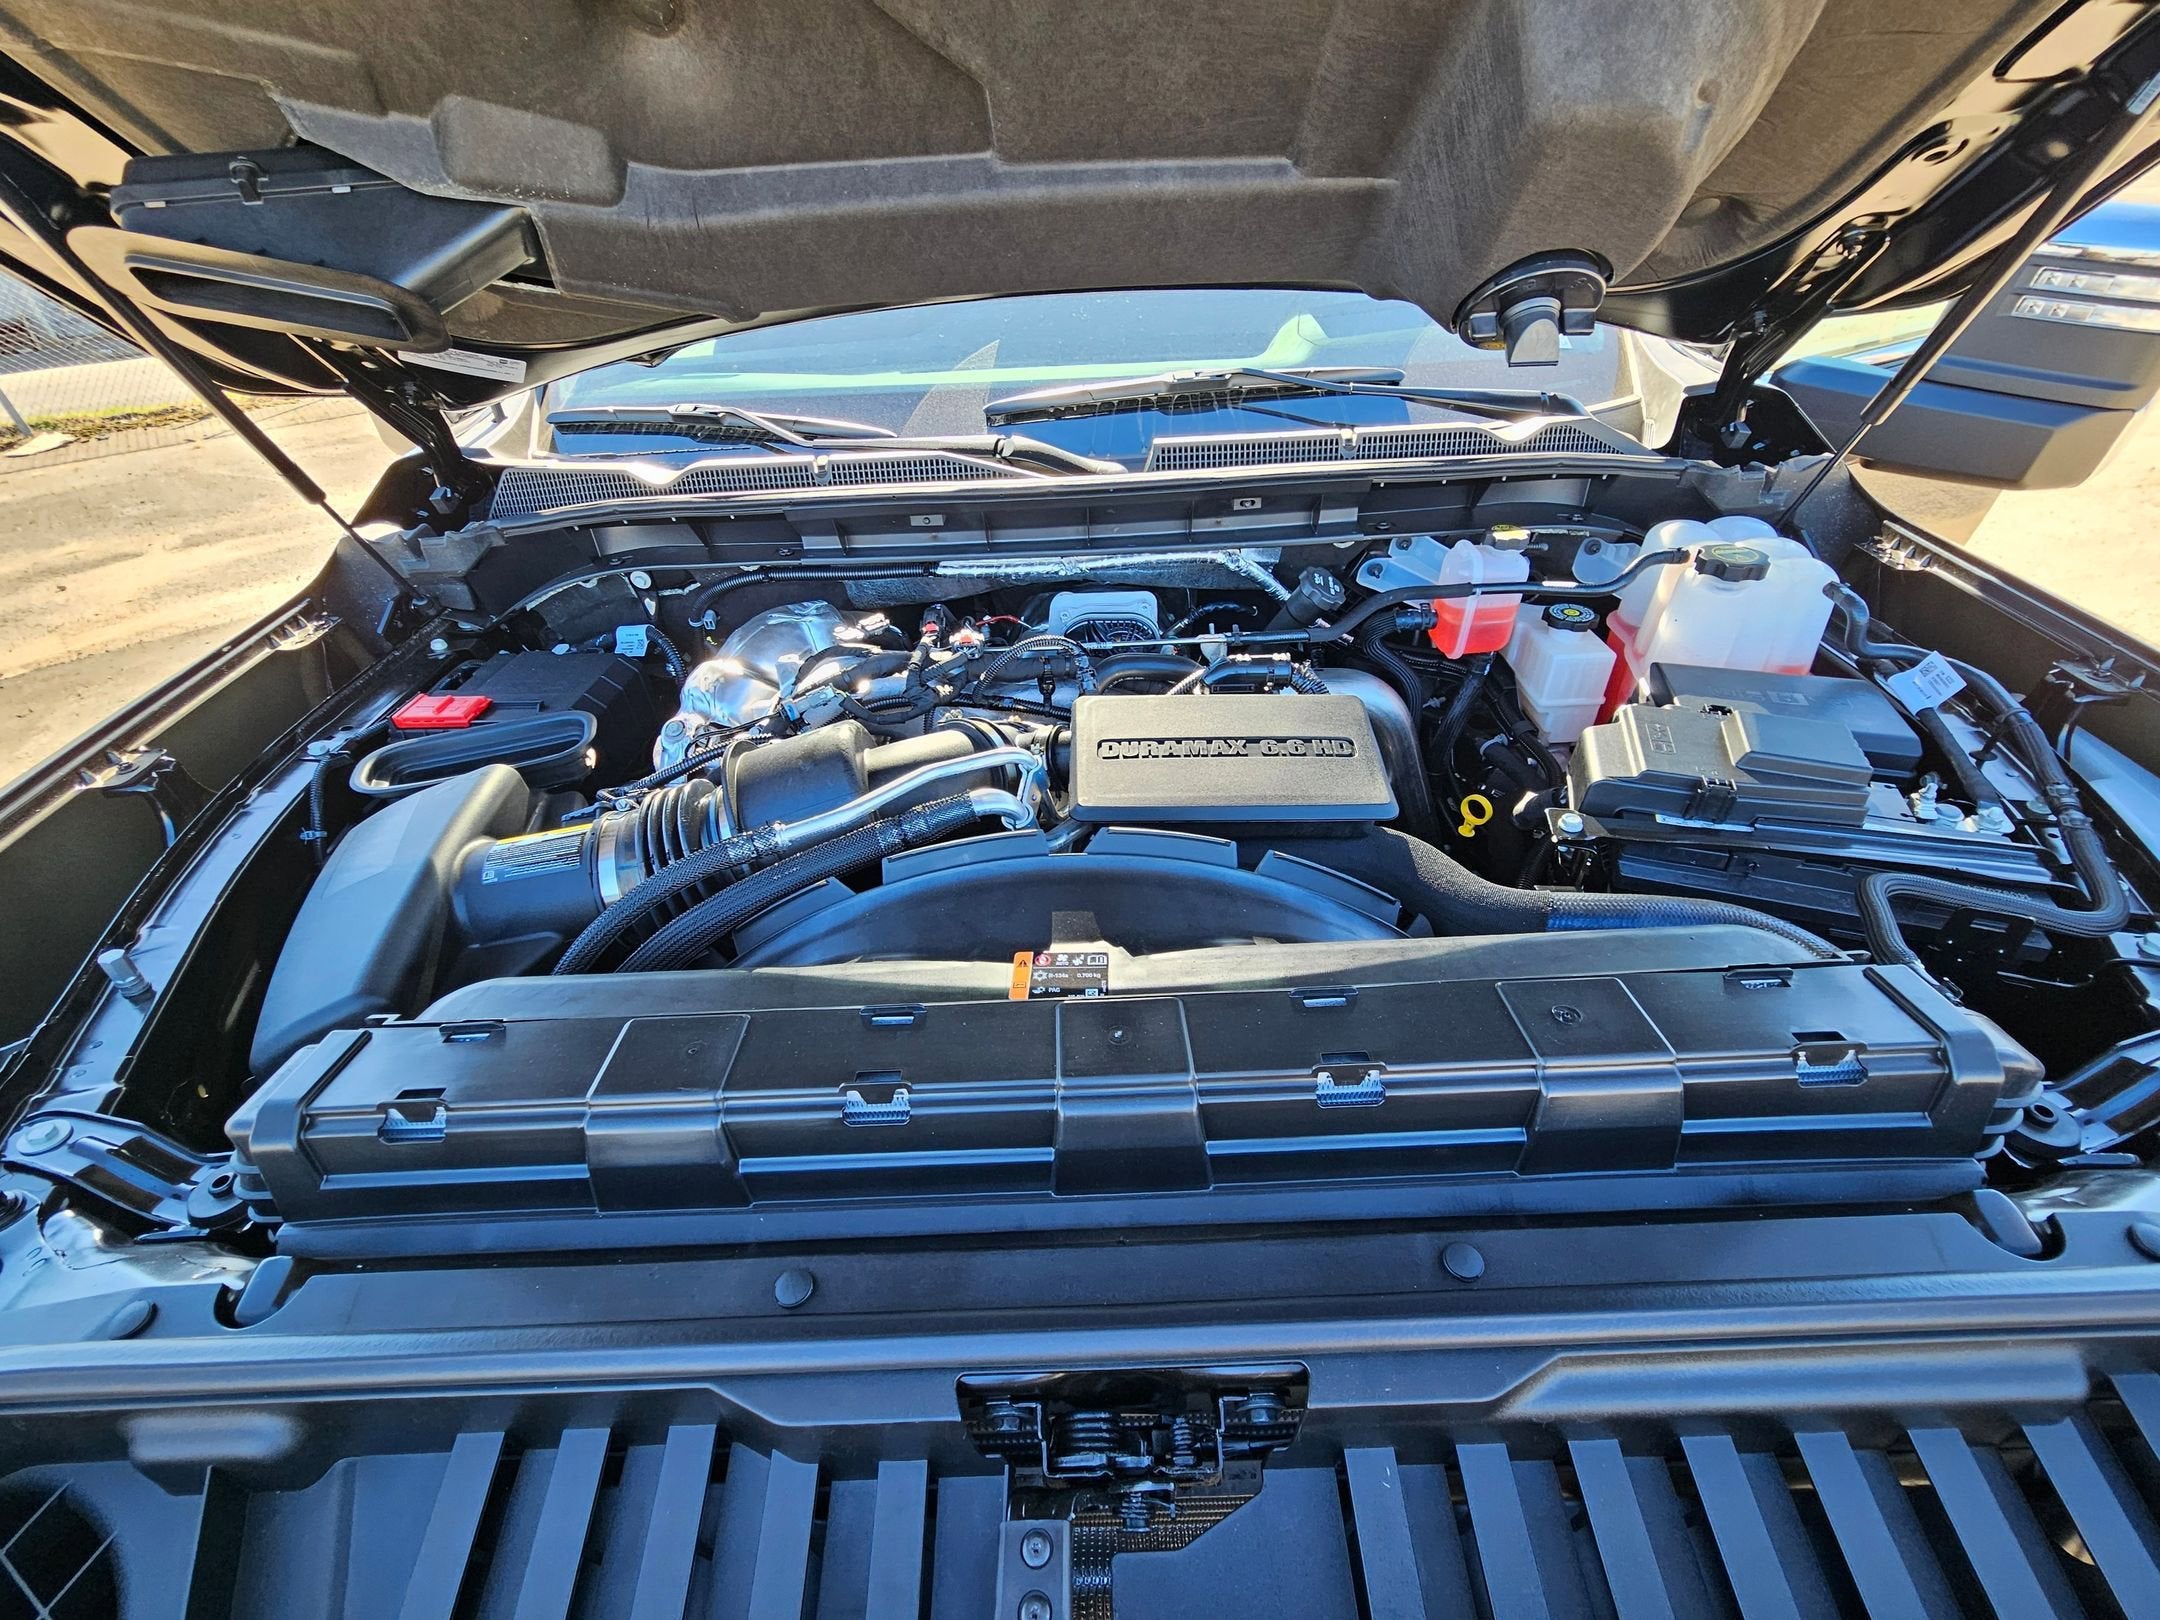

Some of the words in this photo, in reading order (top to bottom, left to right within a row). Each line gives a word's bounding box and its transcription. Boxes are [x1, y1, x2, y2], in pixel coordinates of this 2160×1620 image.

[1101, 739, 1248, 759] DURAMAX
[1260, 739, 1307, 756] 6.6
[1312, 738, 1354, 757] HD
